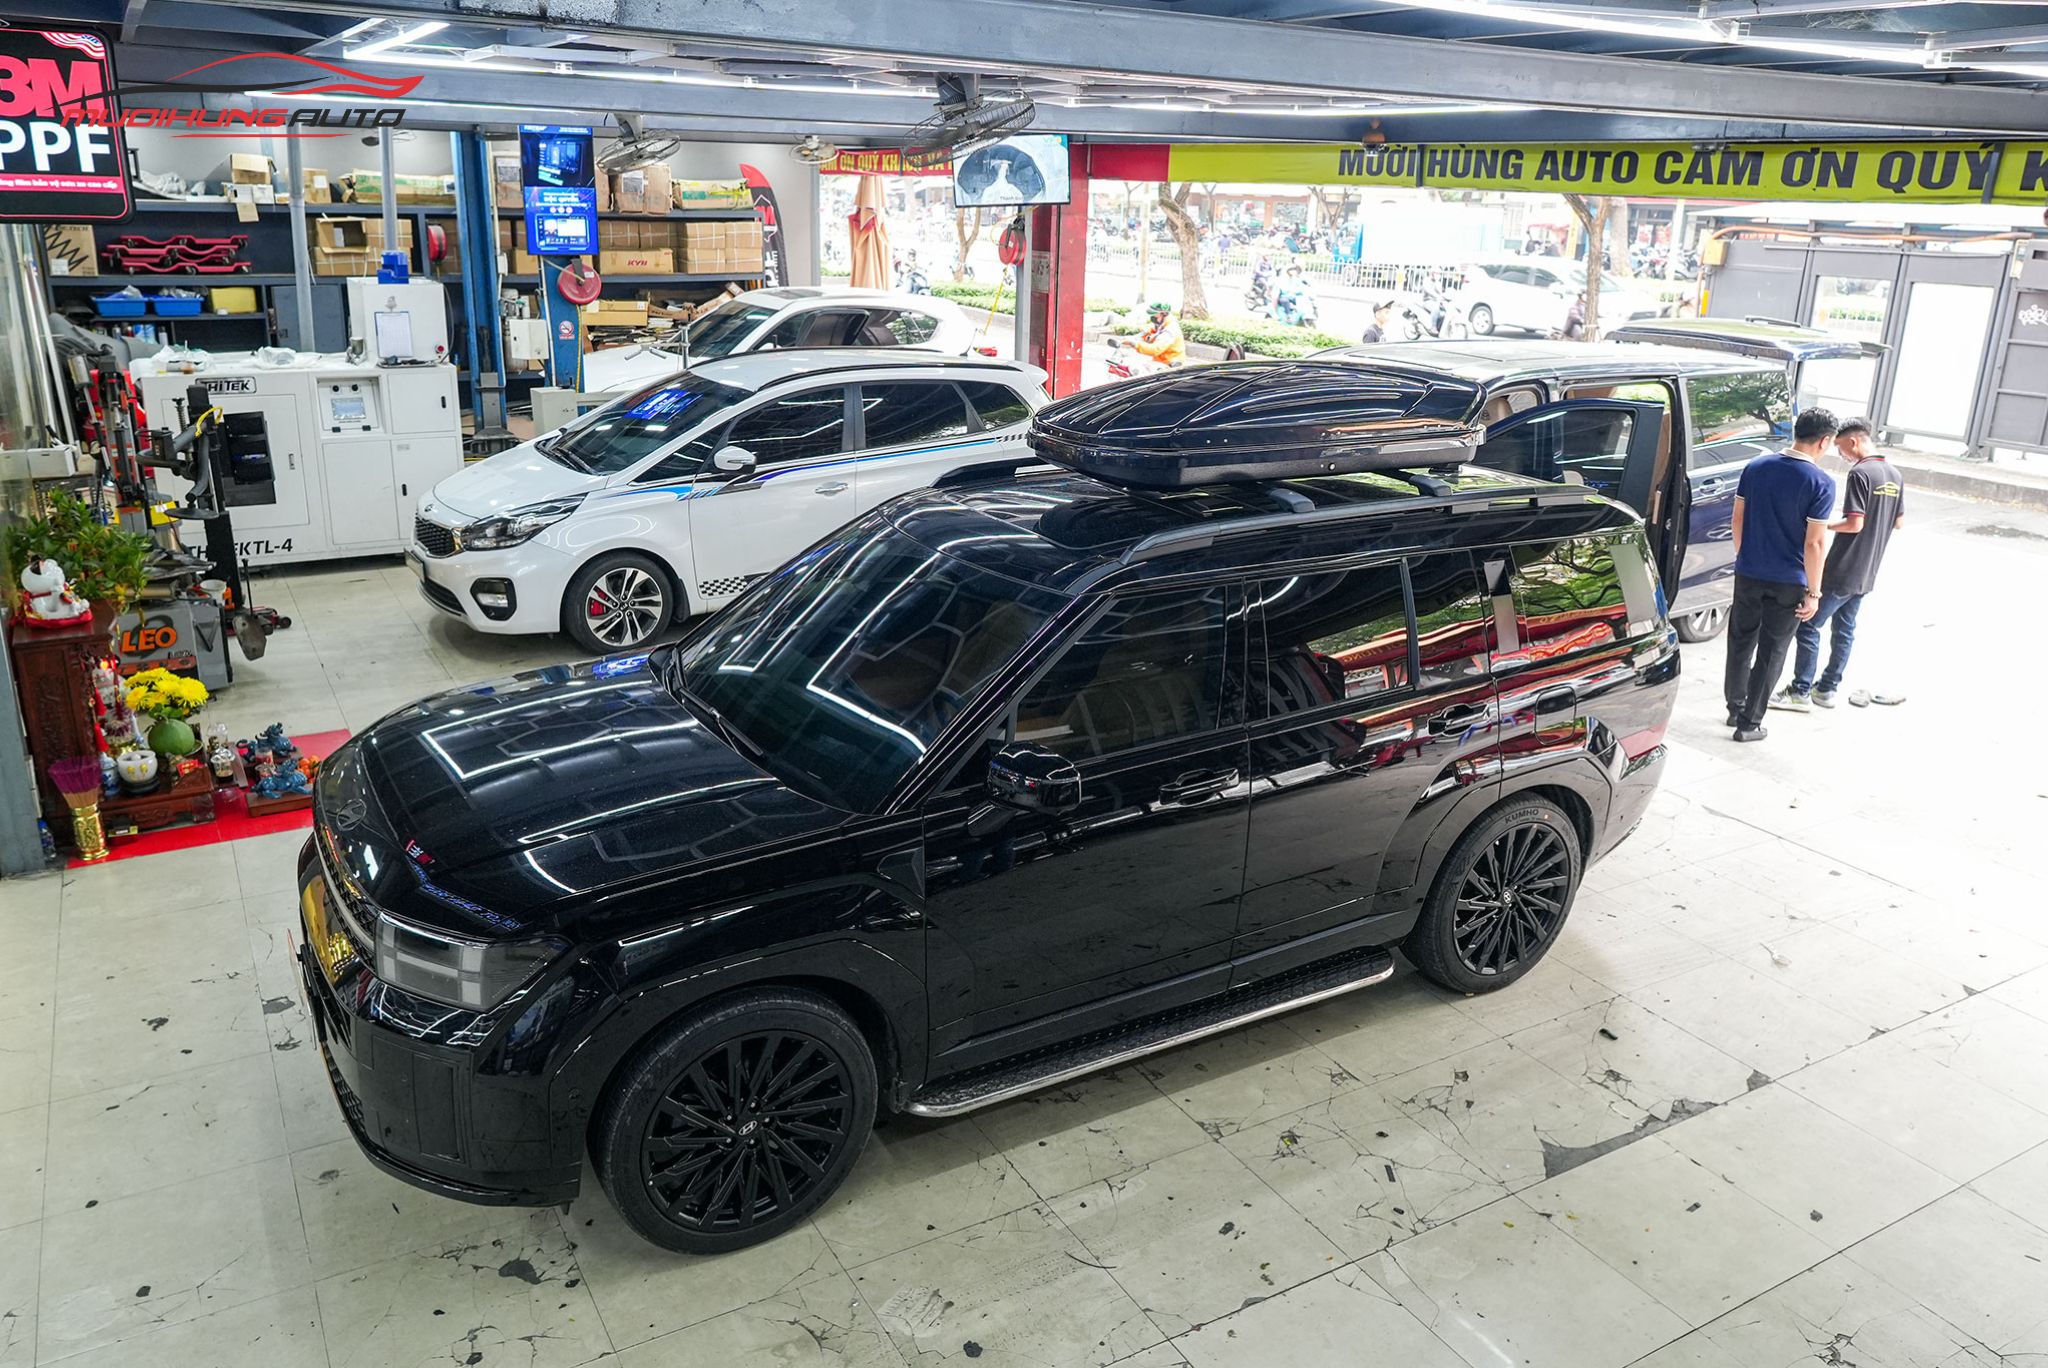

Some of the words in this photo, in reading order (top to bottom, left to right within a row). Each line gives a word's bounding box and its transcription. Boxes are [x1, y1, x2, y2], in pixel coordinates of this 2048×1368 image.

[0, 55, 106, 117] 3M
[0, 120, 110, 173] PPF
[1427, 143, 1524, 180] HÙNG
[1535, 150, 1639, 183] AUTO
[1780, 147, 1859, 189] ƠN
[1876, 142, 1997, 194] QUÝ
[121, 626, 178, 653] LEO
[1504, 808, 1540, 824] KUMHO
